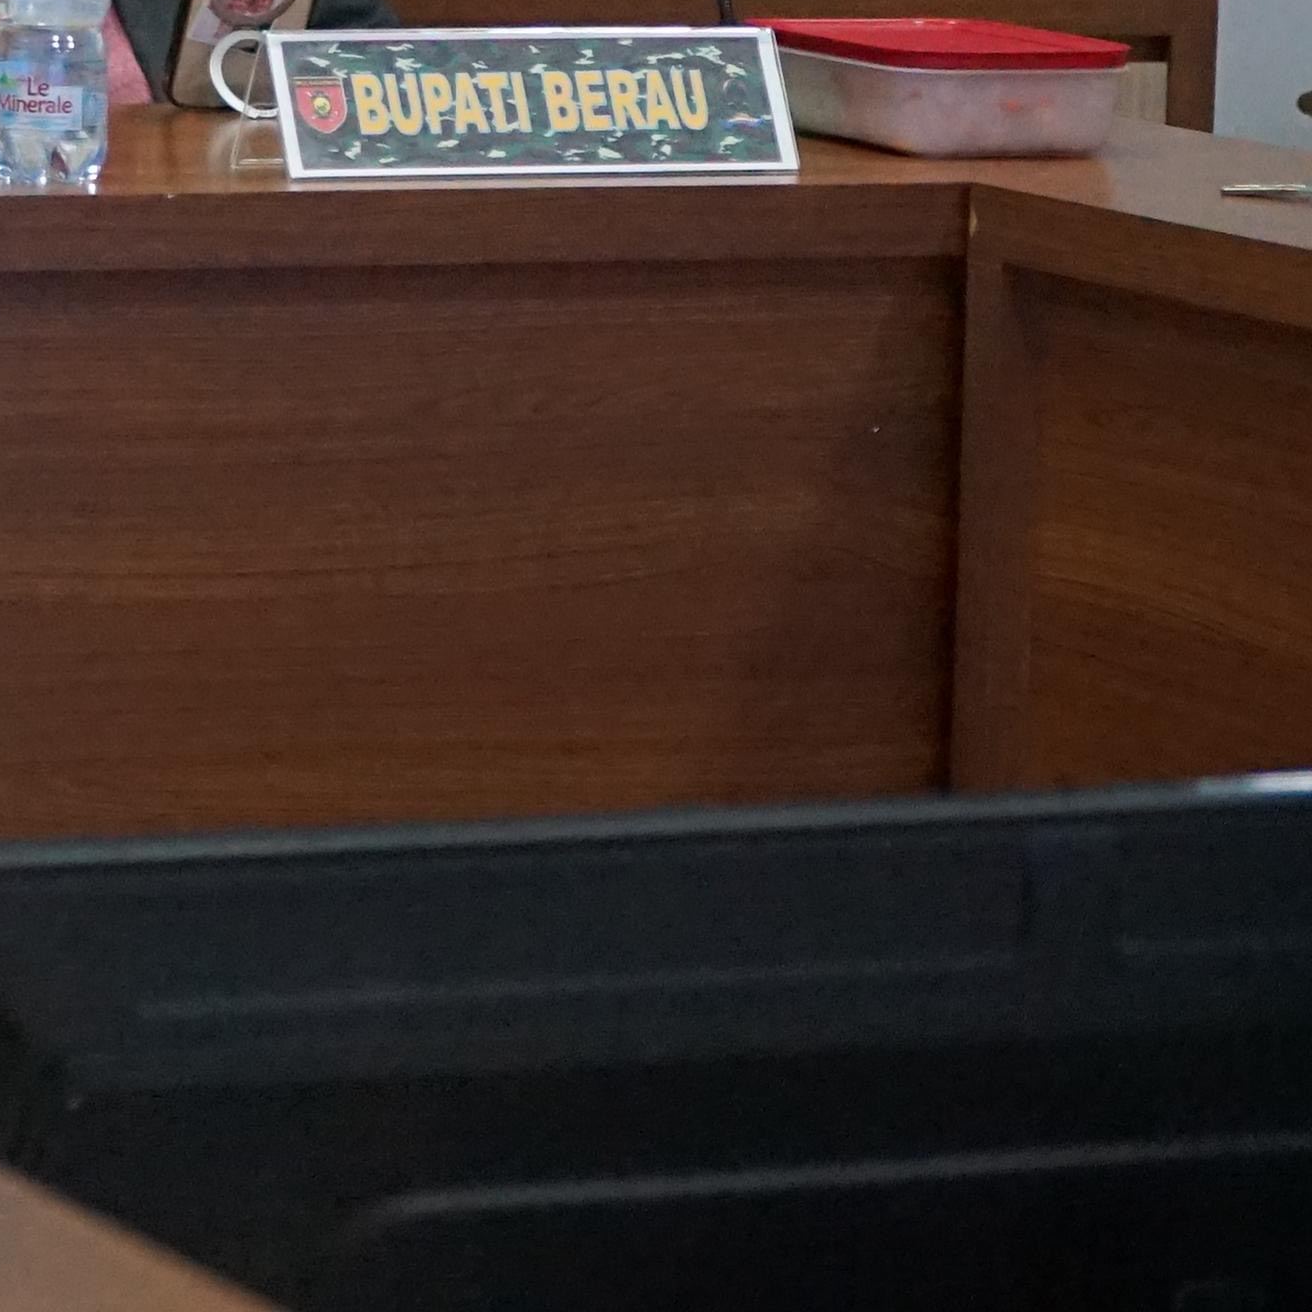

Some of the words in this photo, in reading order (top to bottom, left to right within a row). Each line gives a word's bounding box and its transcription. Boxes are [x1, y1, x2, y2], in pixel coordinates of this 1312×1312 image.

[27, 76, 50, 96] Le
[350, 71, 533, 136] BUPATI
[541, 69, 710, 133] BERAU
